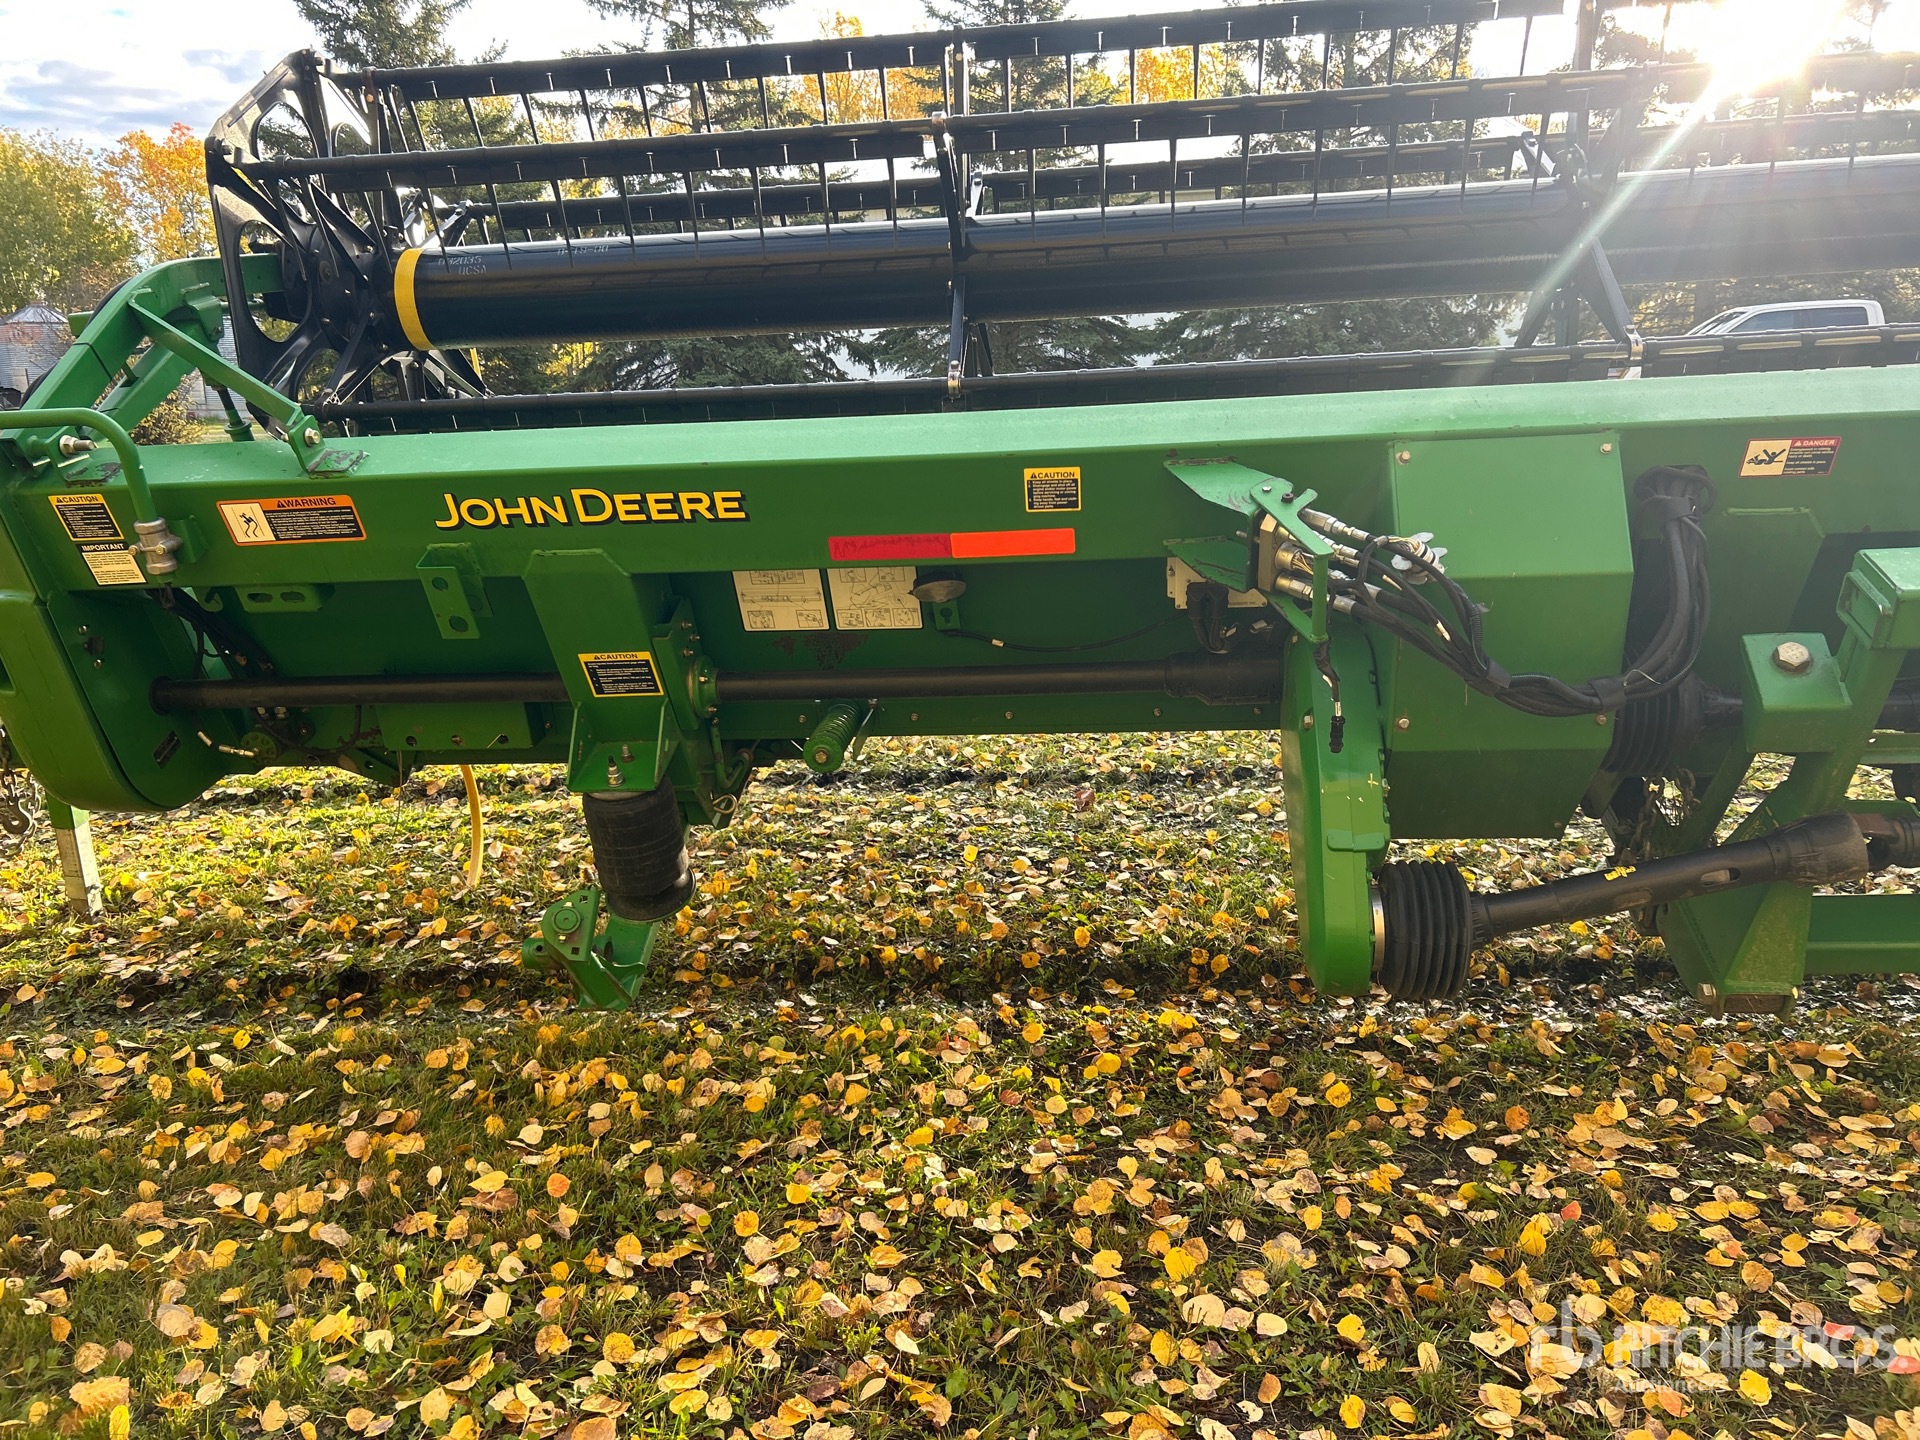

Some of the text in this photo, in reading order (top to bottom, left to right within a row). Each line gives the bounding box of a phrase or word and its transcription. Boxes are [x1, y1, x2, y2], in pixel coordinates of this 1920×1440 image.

[1802, 439, 1835, 447] DANGER
[1037, 471, 1075, 479] CAUTION
[284, 497, 336, 508] WARNING
[435, 488, 750, 530] JOHN DEERE
[81, 543, 125, 552] IMPORTANT
